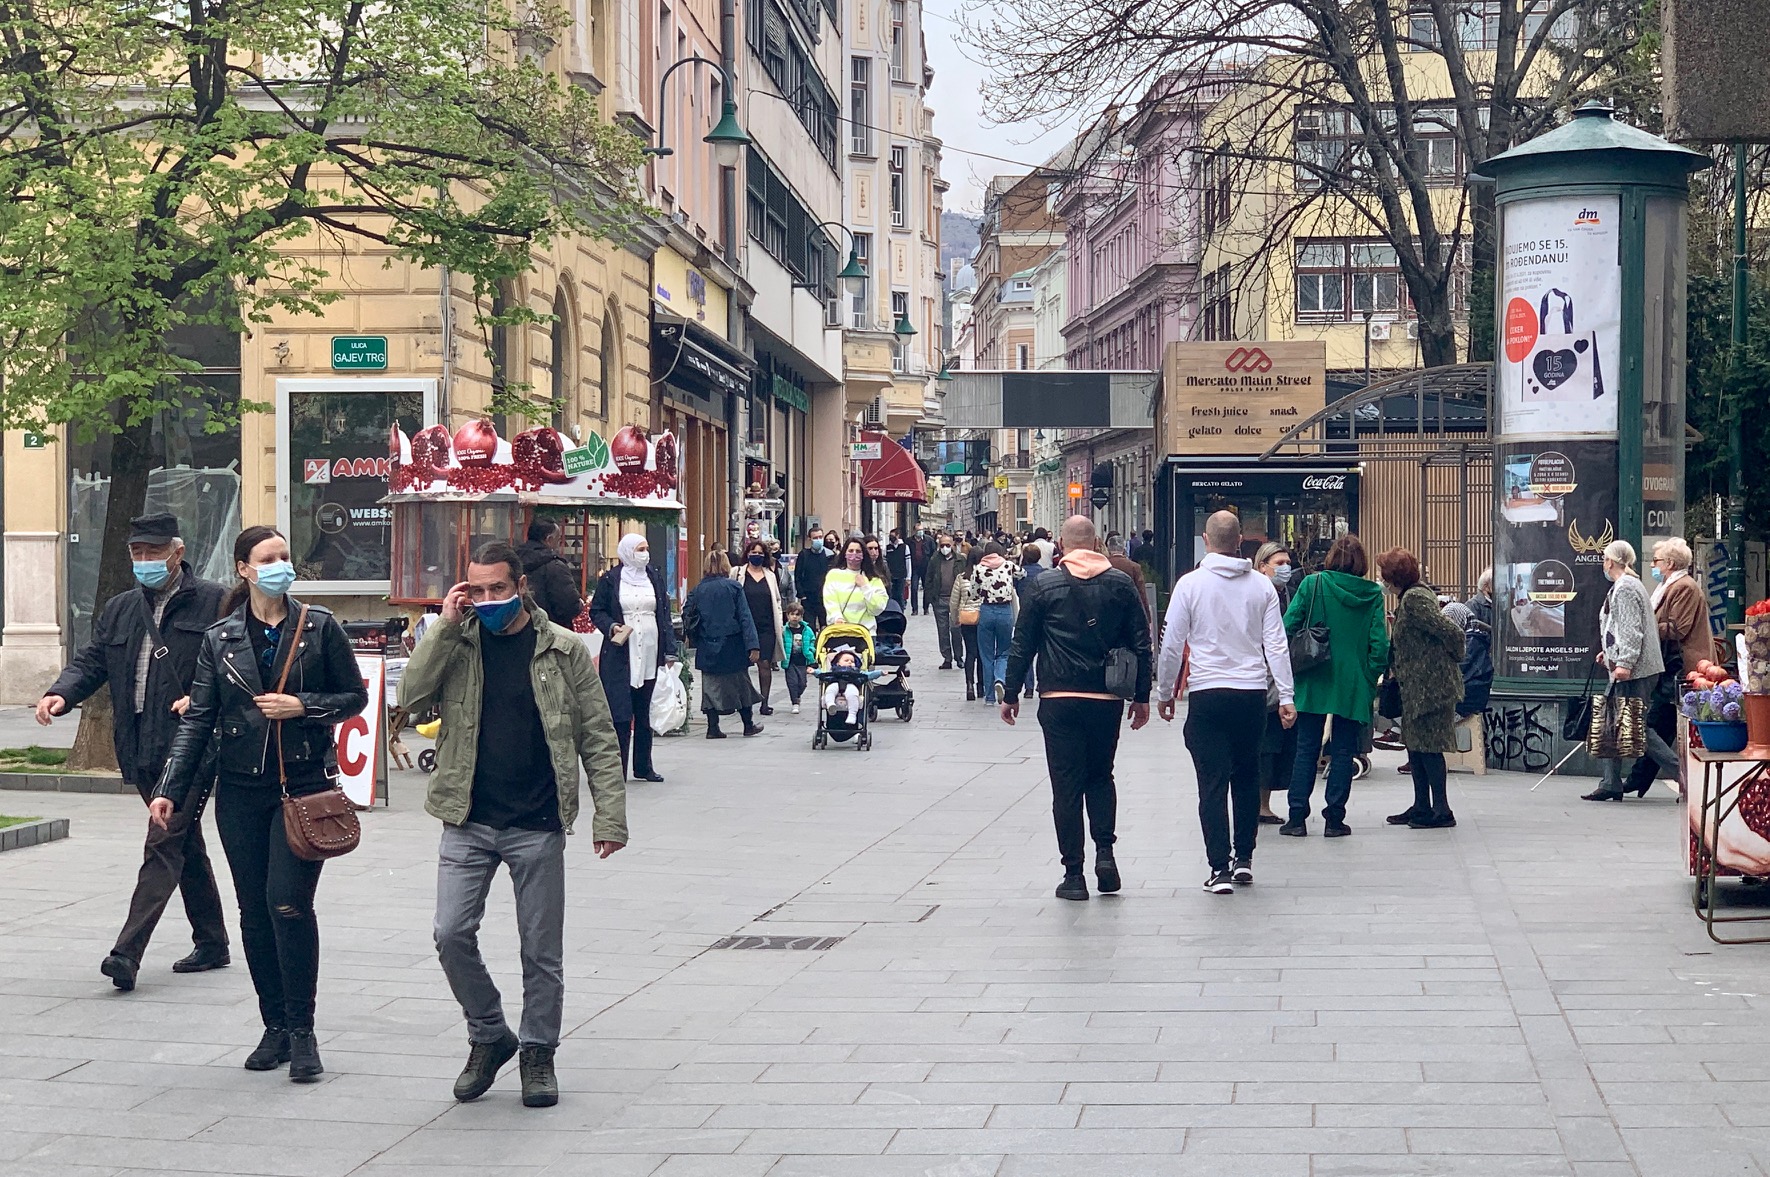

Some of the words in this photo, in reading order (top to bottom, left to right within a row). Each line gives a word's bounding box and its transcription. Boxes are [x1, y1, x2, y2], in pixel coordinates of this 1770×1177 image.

[1578, 208, 1598, 219] dm
[1538, 239, 1551, 251] SE
[1554, 239, 1569, 249] 15.
[334, 353, 364, 363] GAJEV
[365, 353, 385, 363] TRG
[1545, 355, 1563, 372] 15
[1186, 375, 1238, 387] Mercato
[1240, 375, 1272, 386] Main
[1276, 375, 1312, 386] Street
[1222, 405, 1249, 418] juice
[1269, 405, 1298, 416] snack
[1188, 425, 1223, 439] gelato
[1234, 425, 1262, 435] dolce
[30, 435, 38, 446] 2
[853, 443, 868, 451] HM
[567, 459, 595, 470] NATURE
[1544, 646, 1573, 654] ANGELS
[1574, 646, 1590, 654] BHF
